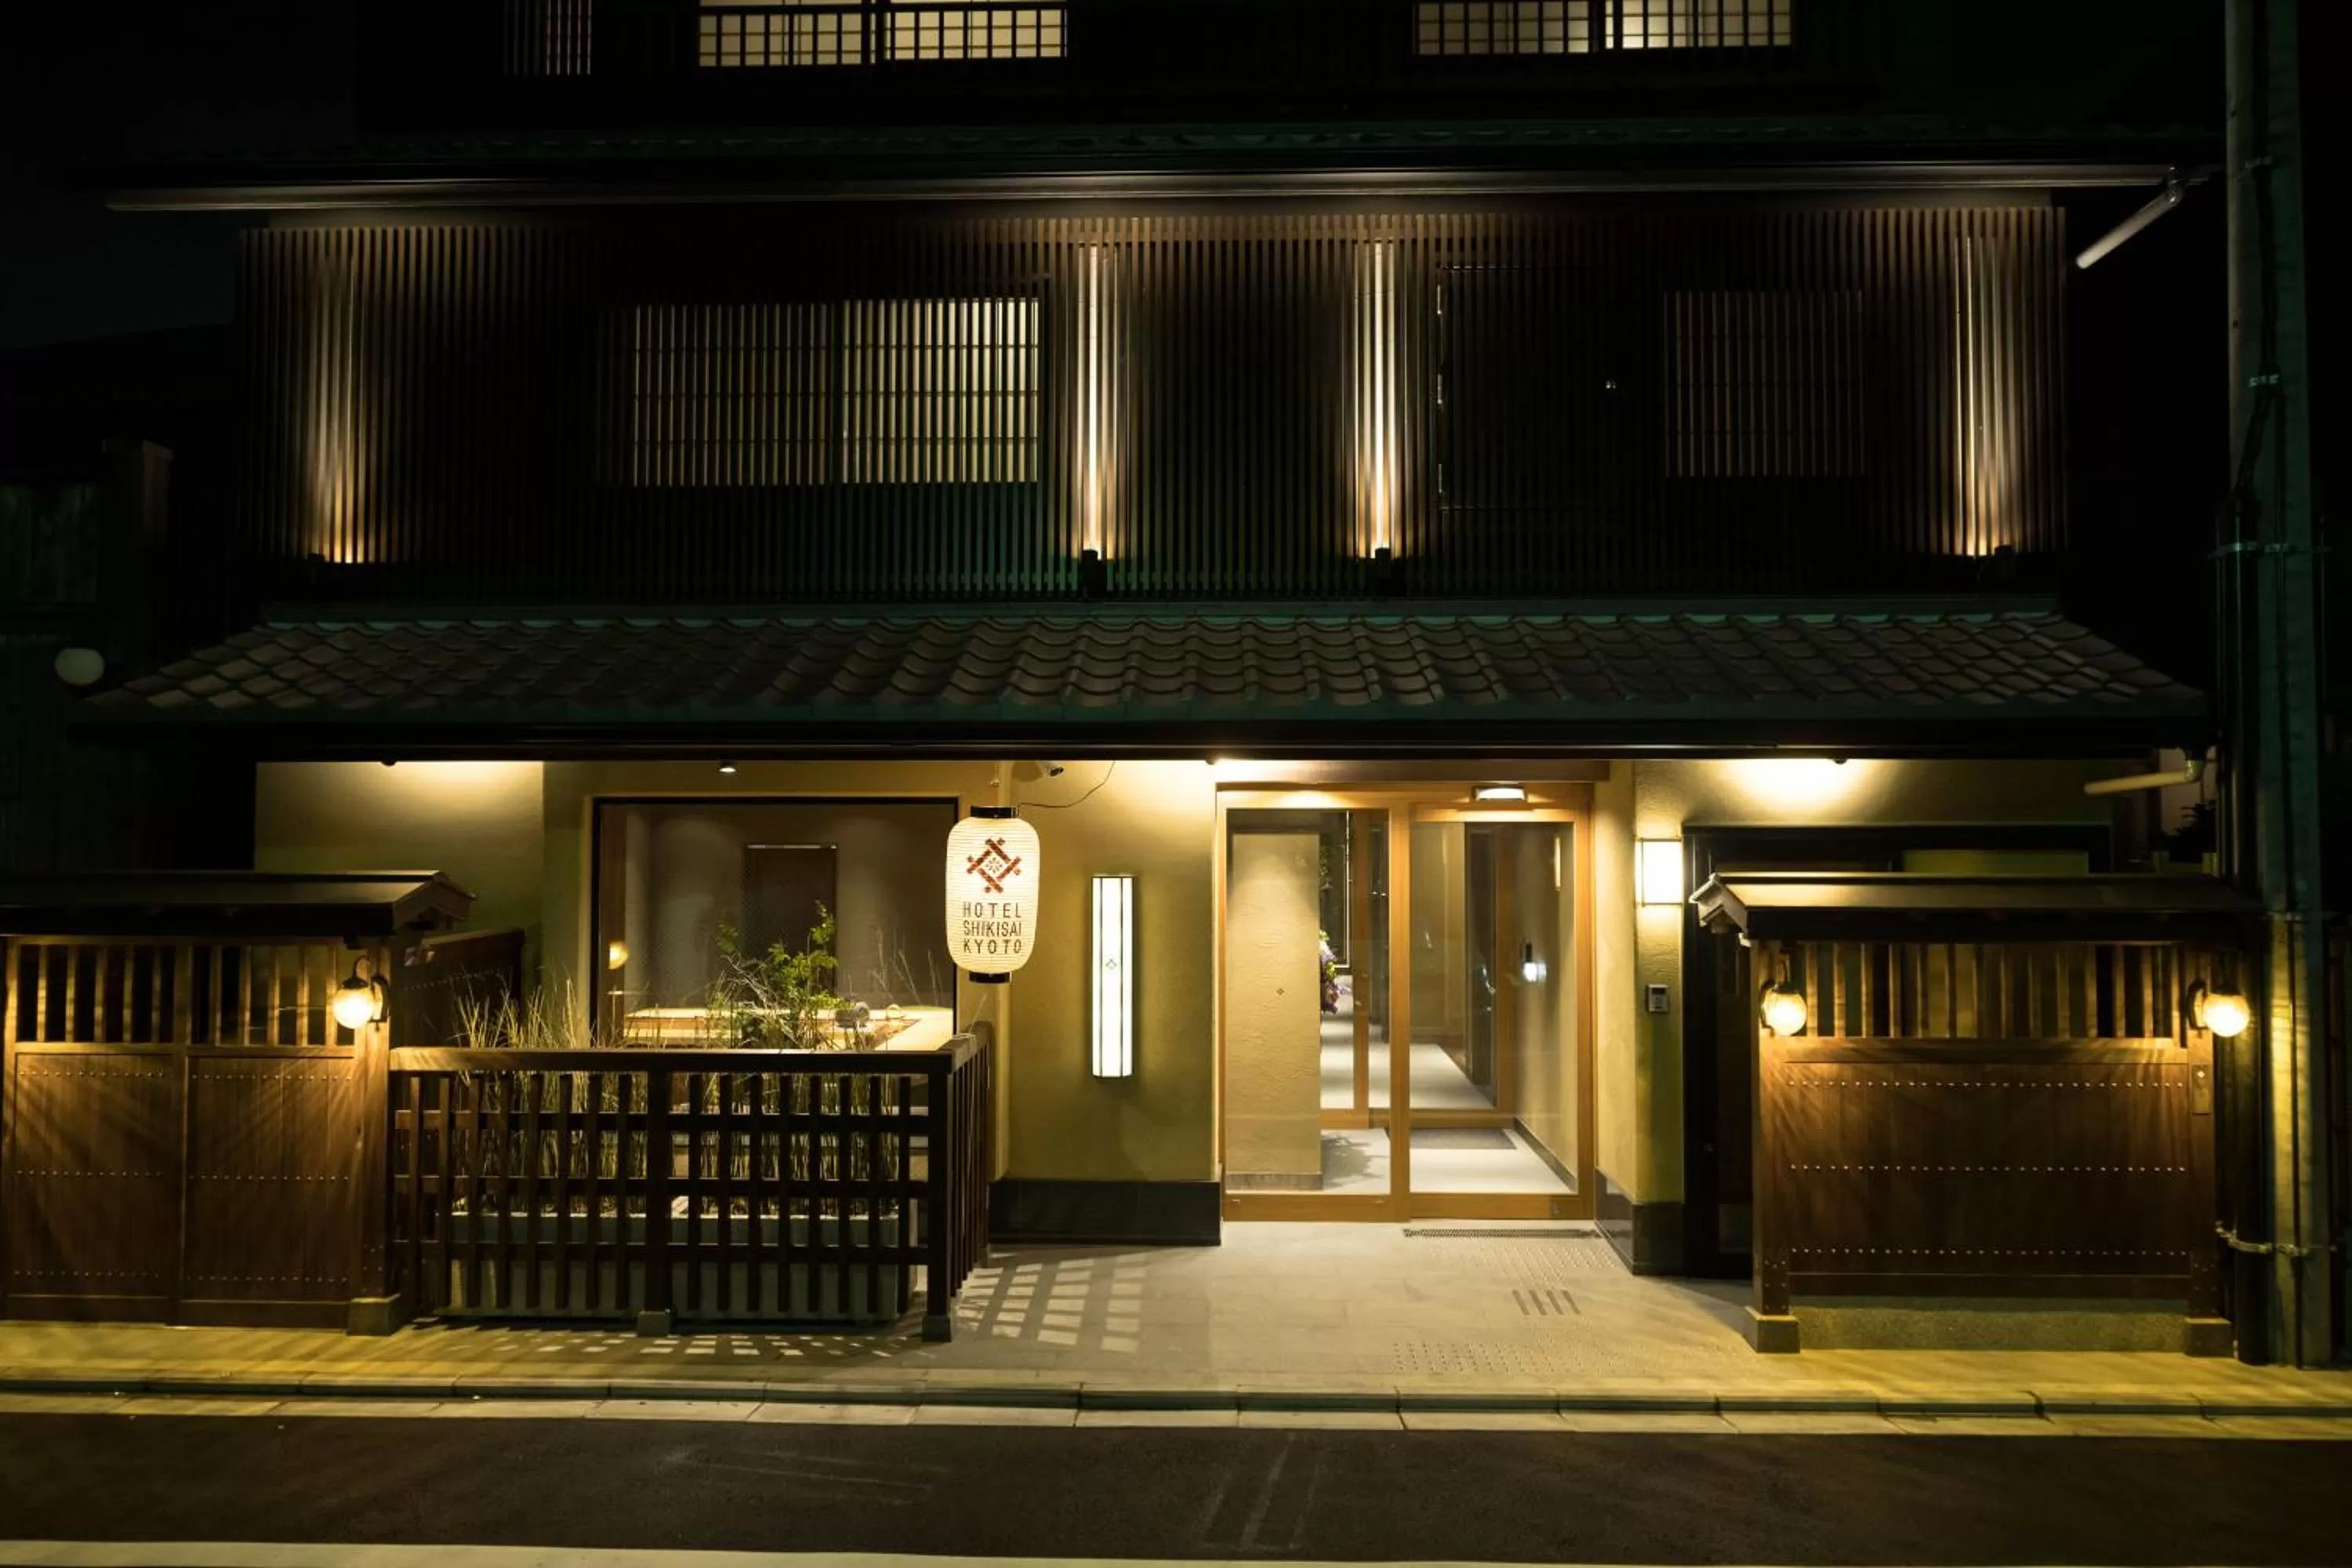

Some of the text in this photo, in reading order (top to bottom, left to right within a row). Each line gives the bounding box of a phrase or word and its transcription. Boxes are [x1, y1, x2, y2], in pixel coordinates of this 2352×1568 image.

[963, 902, 1022, 918] HOTEL
[964, 920, 1022, 937] SHIKISAI
[964, 939, 1022, 954] KYOTO
